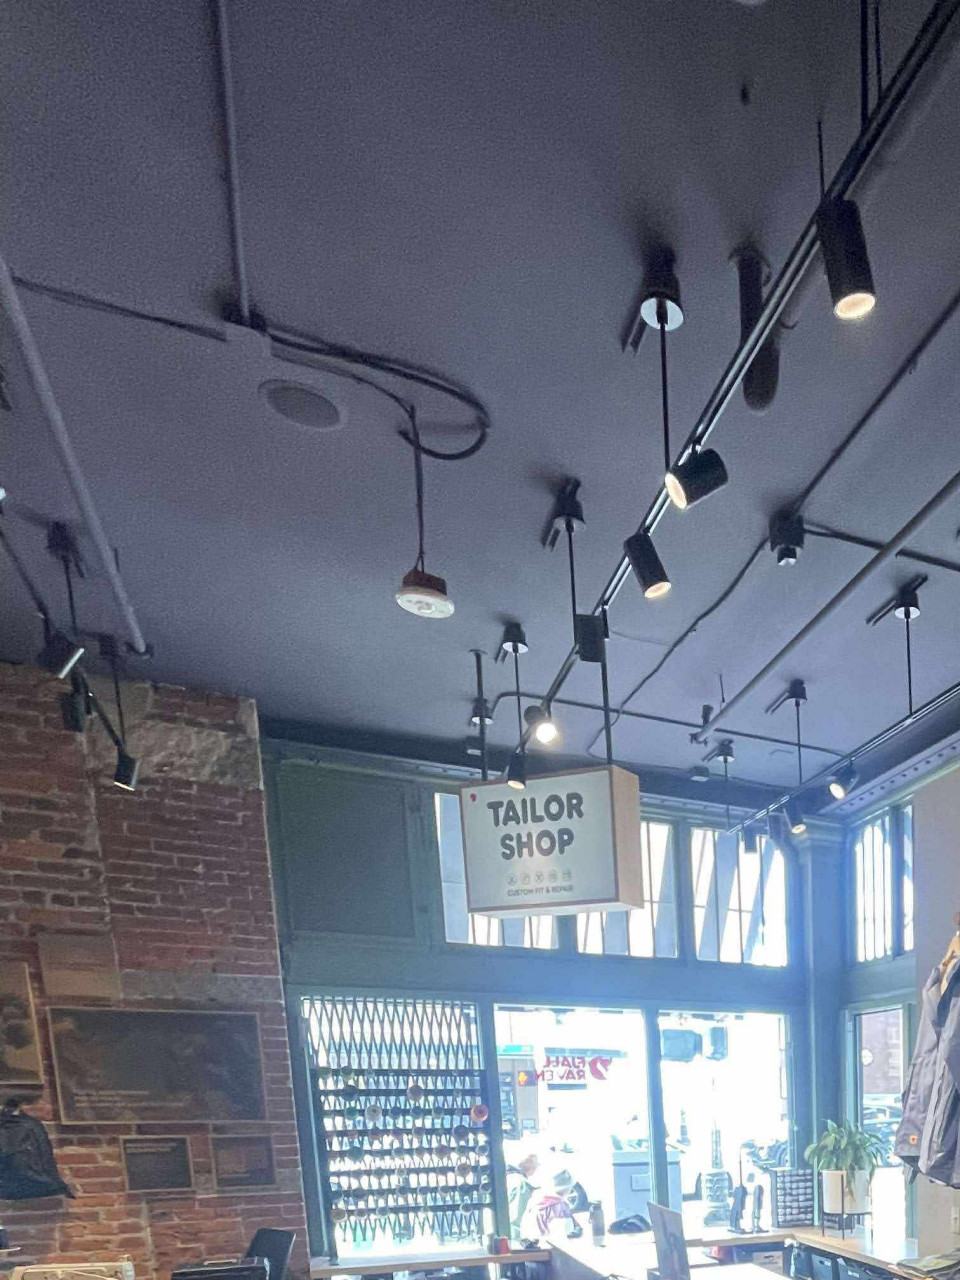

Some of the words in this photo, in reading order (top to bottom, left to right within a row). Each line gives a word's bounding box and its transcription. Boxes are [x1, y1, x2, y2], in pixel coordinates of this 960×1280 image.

[487, 792, 584, 827] TAILOR
[500, 828, 574, 860] SHOP
[507, 888, 533, 897] CUSTOM
[535, 887, 544, 895] FIT
[545, 886, 551, 894] &
